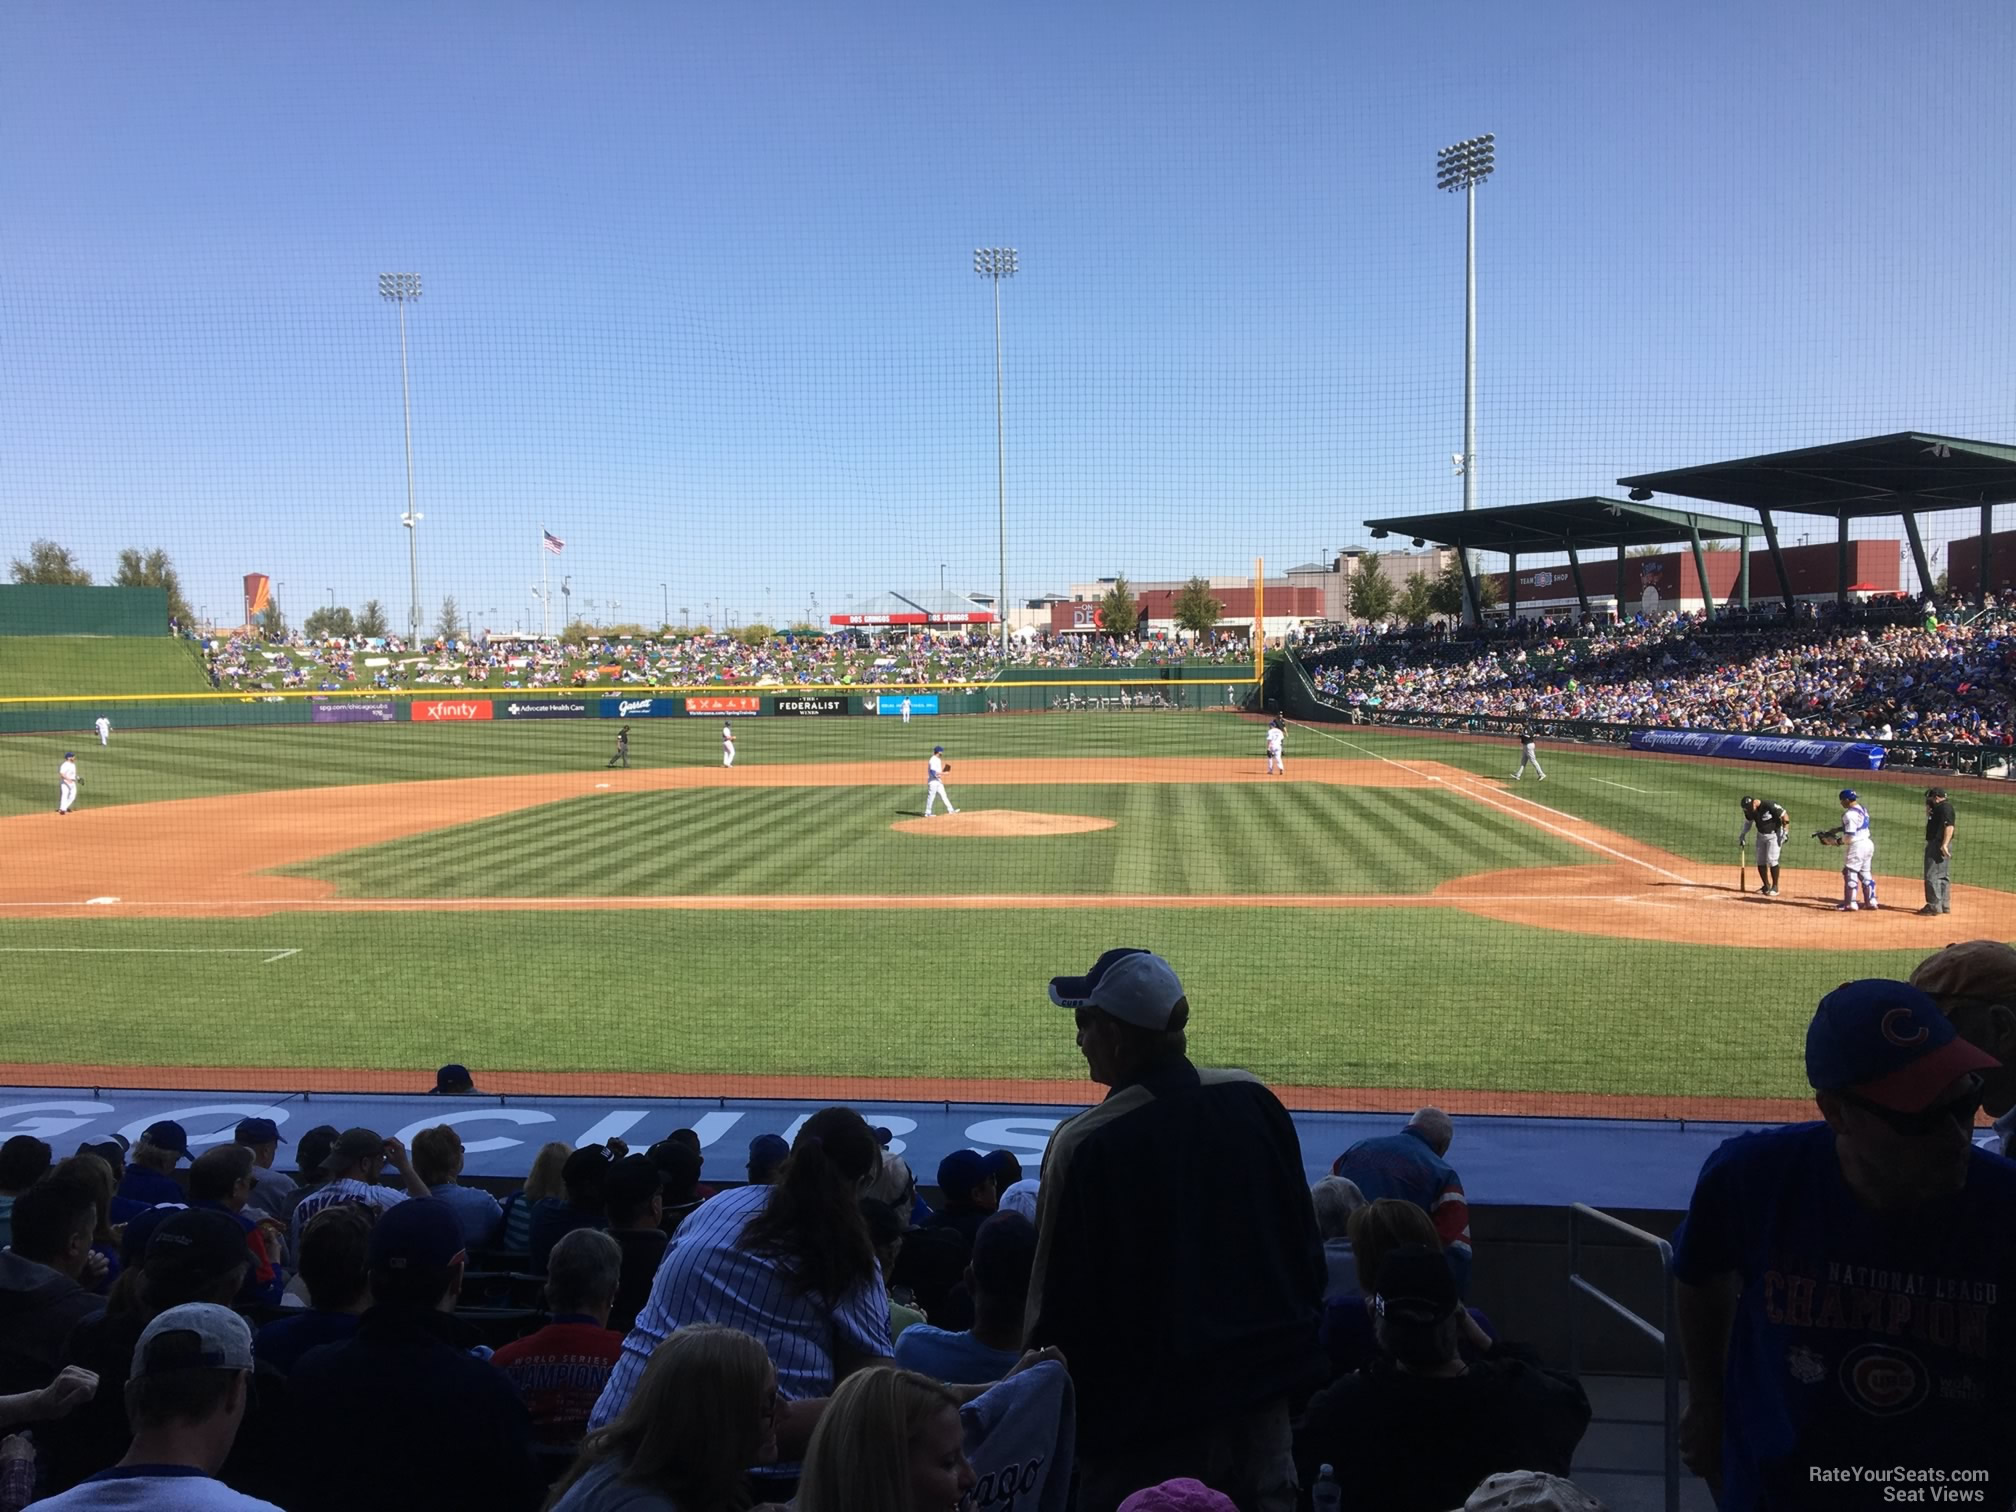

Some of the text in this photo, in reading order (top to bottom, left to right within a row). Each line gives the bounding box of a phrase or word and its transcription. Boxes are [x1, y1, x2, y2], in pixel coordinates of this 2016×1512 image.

[1520, 573, 1568, 585] TEAM SHOP
[850, 615, 890, 624] DOS GRINGOS
[942, 613, 969, 622] GRINGOS
[1074, 609, 1104, 629] DEC
[427, 702, 478, 719] xfinity
[779, 702, 840, 711] FEDERALIST
[1641, 730, 1710, 750] Reynolds Wrap
[1739, 736, 1827, 759] Reynolds Wrap
[1881, 1007, 1930, 1049] C
[1827, 1261, 1927, 1298] NATIONAL
[1935, 1276, 1998, 1305] LEAGU
[514, 1354, 609, 1367] WORLD SERIES
